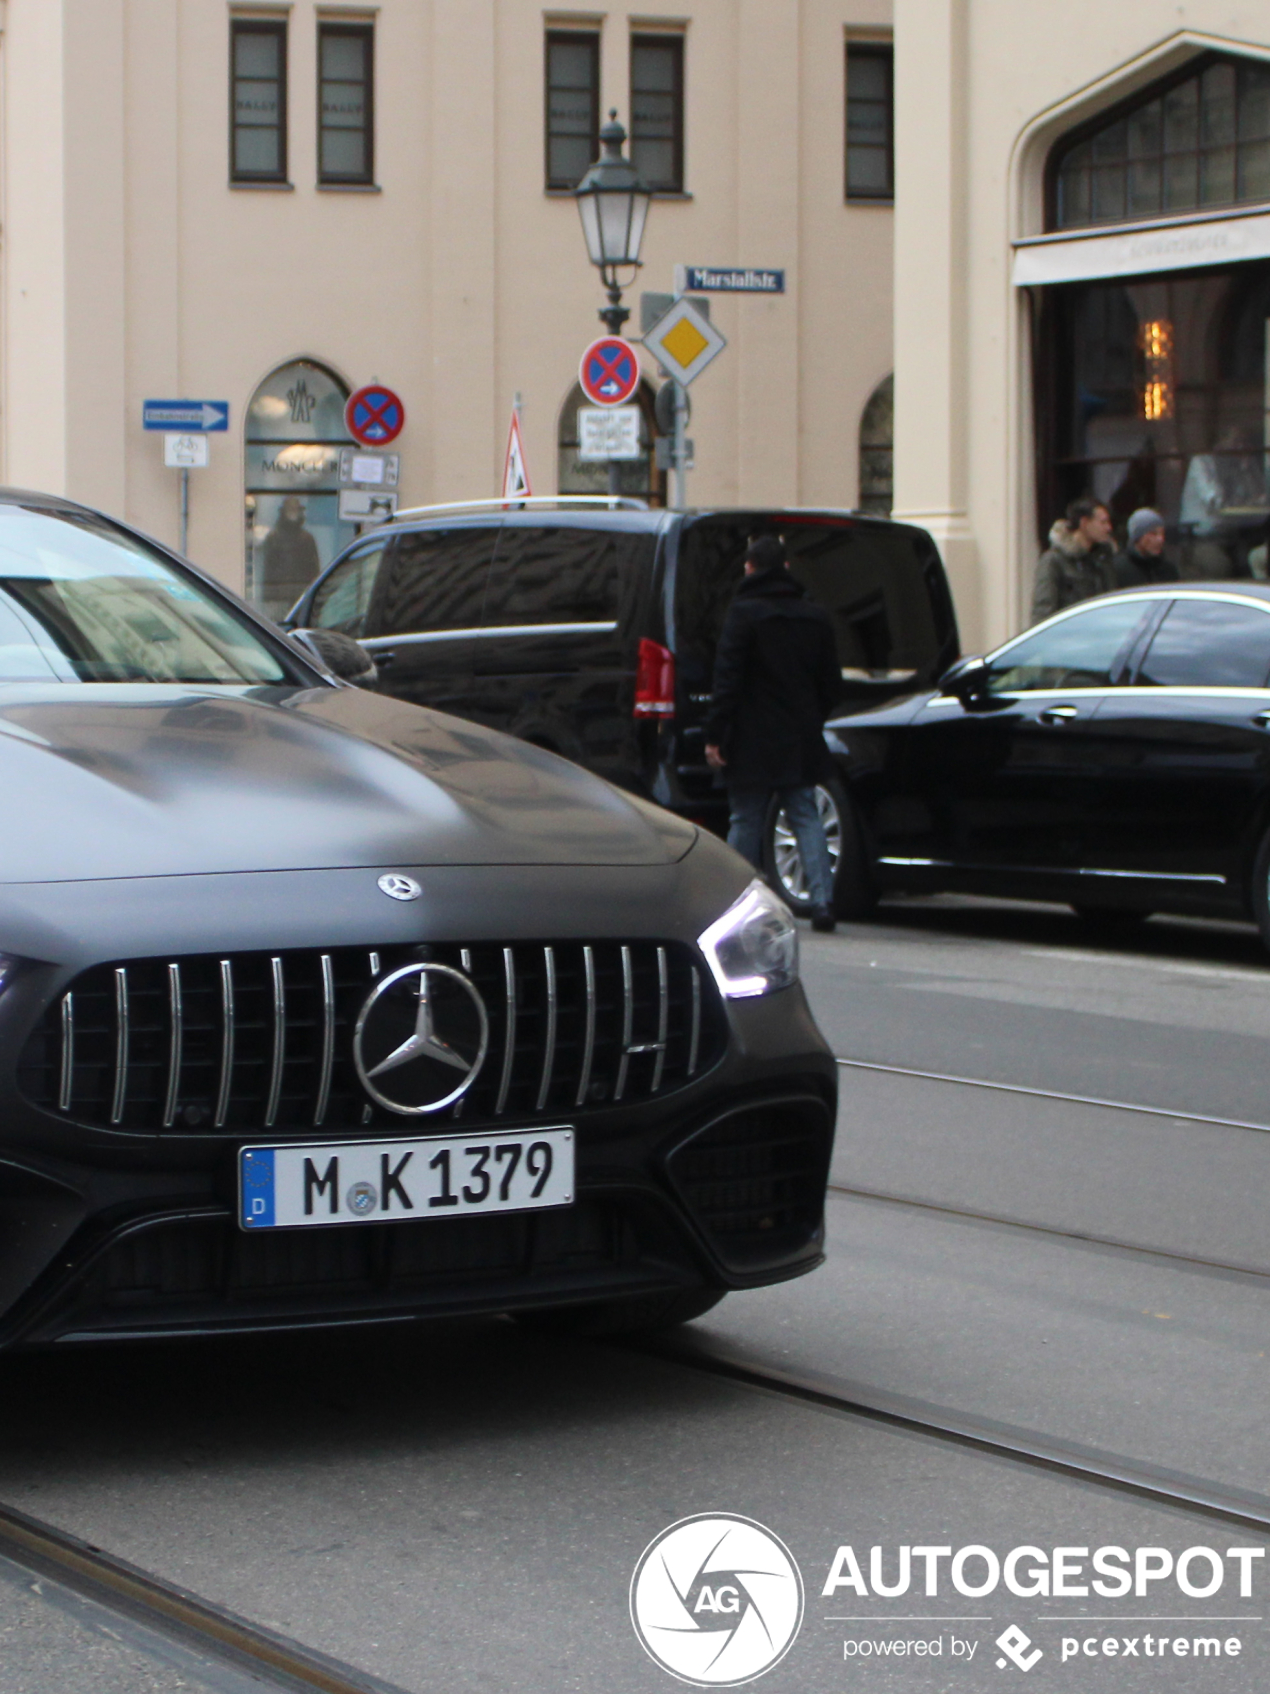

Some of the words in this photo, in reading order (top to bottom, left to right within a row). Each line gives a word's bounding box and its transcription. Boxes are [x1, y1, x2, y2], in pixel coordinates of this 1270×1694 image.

[693, 268, 776, 288] Marstallstr.
[303, 1156, 339, 1216] M
[381, 1151, 414, 1211] K
[428, 1141, 553, 1207] 1379
[252, 1198, 266, 1215] D
